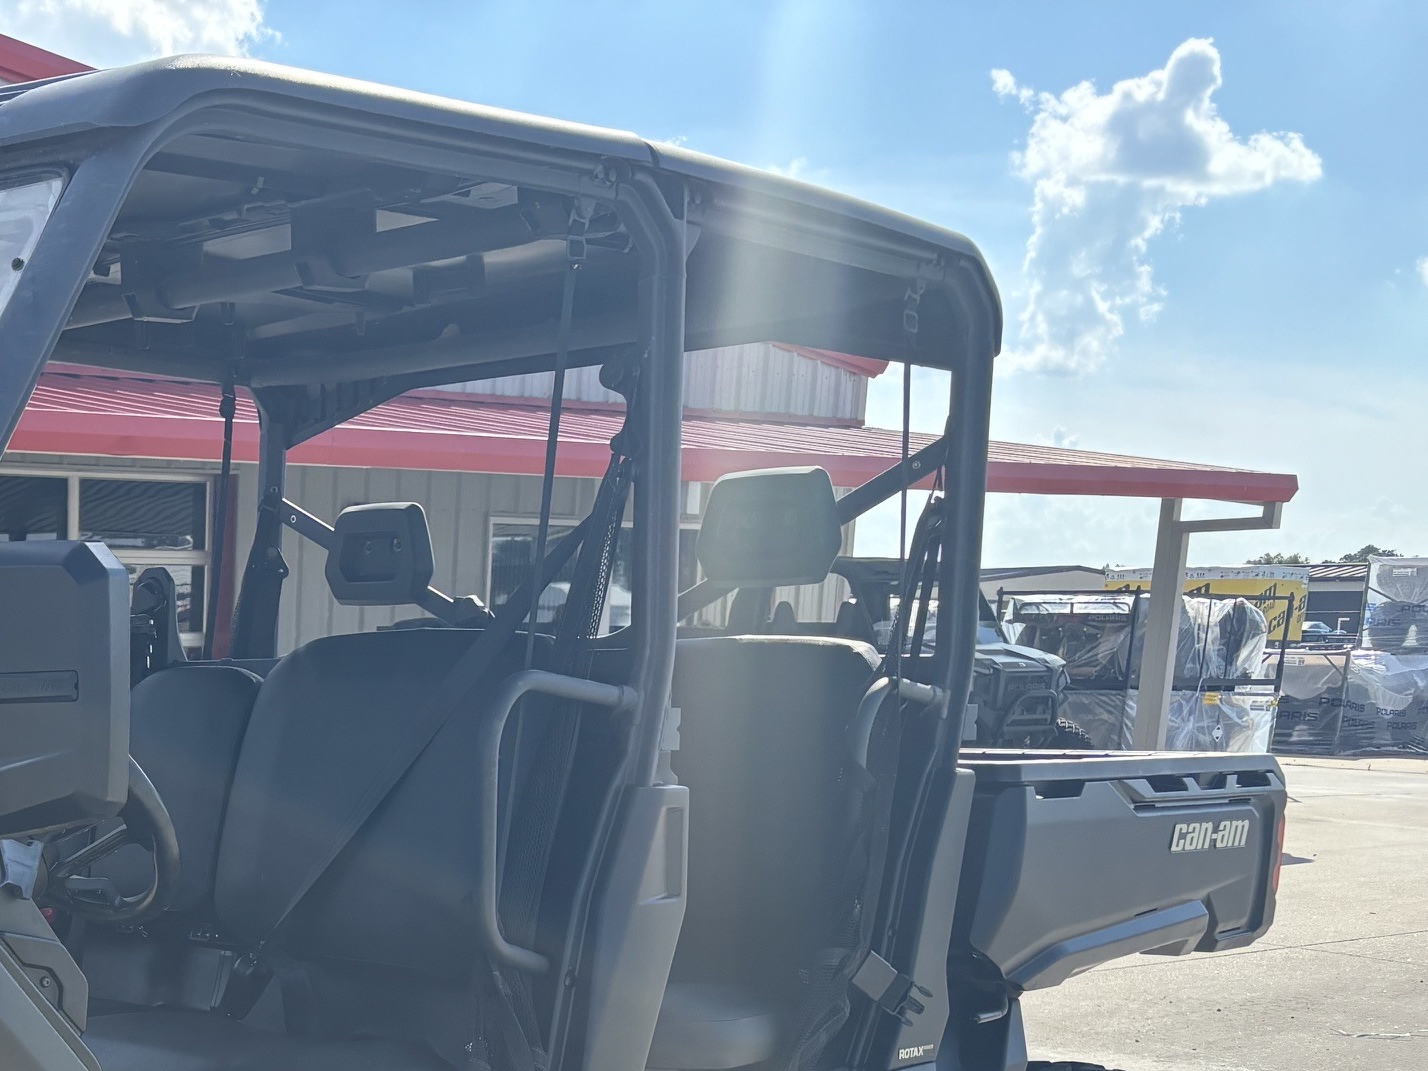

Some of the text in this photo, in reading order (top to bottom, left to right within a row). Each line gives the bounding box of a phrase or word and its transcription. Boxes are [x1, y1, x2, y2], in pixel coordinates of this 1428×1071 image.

[1318, 697, 1365, 712] POLARIS
[1376, 706, 1407, 717] POLARIS
[1387, 721, 1418, 730] POLARIS
[1170, 820, 1250, 852] can-am
[898, 1045, 924, 1060] ROTAX
